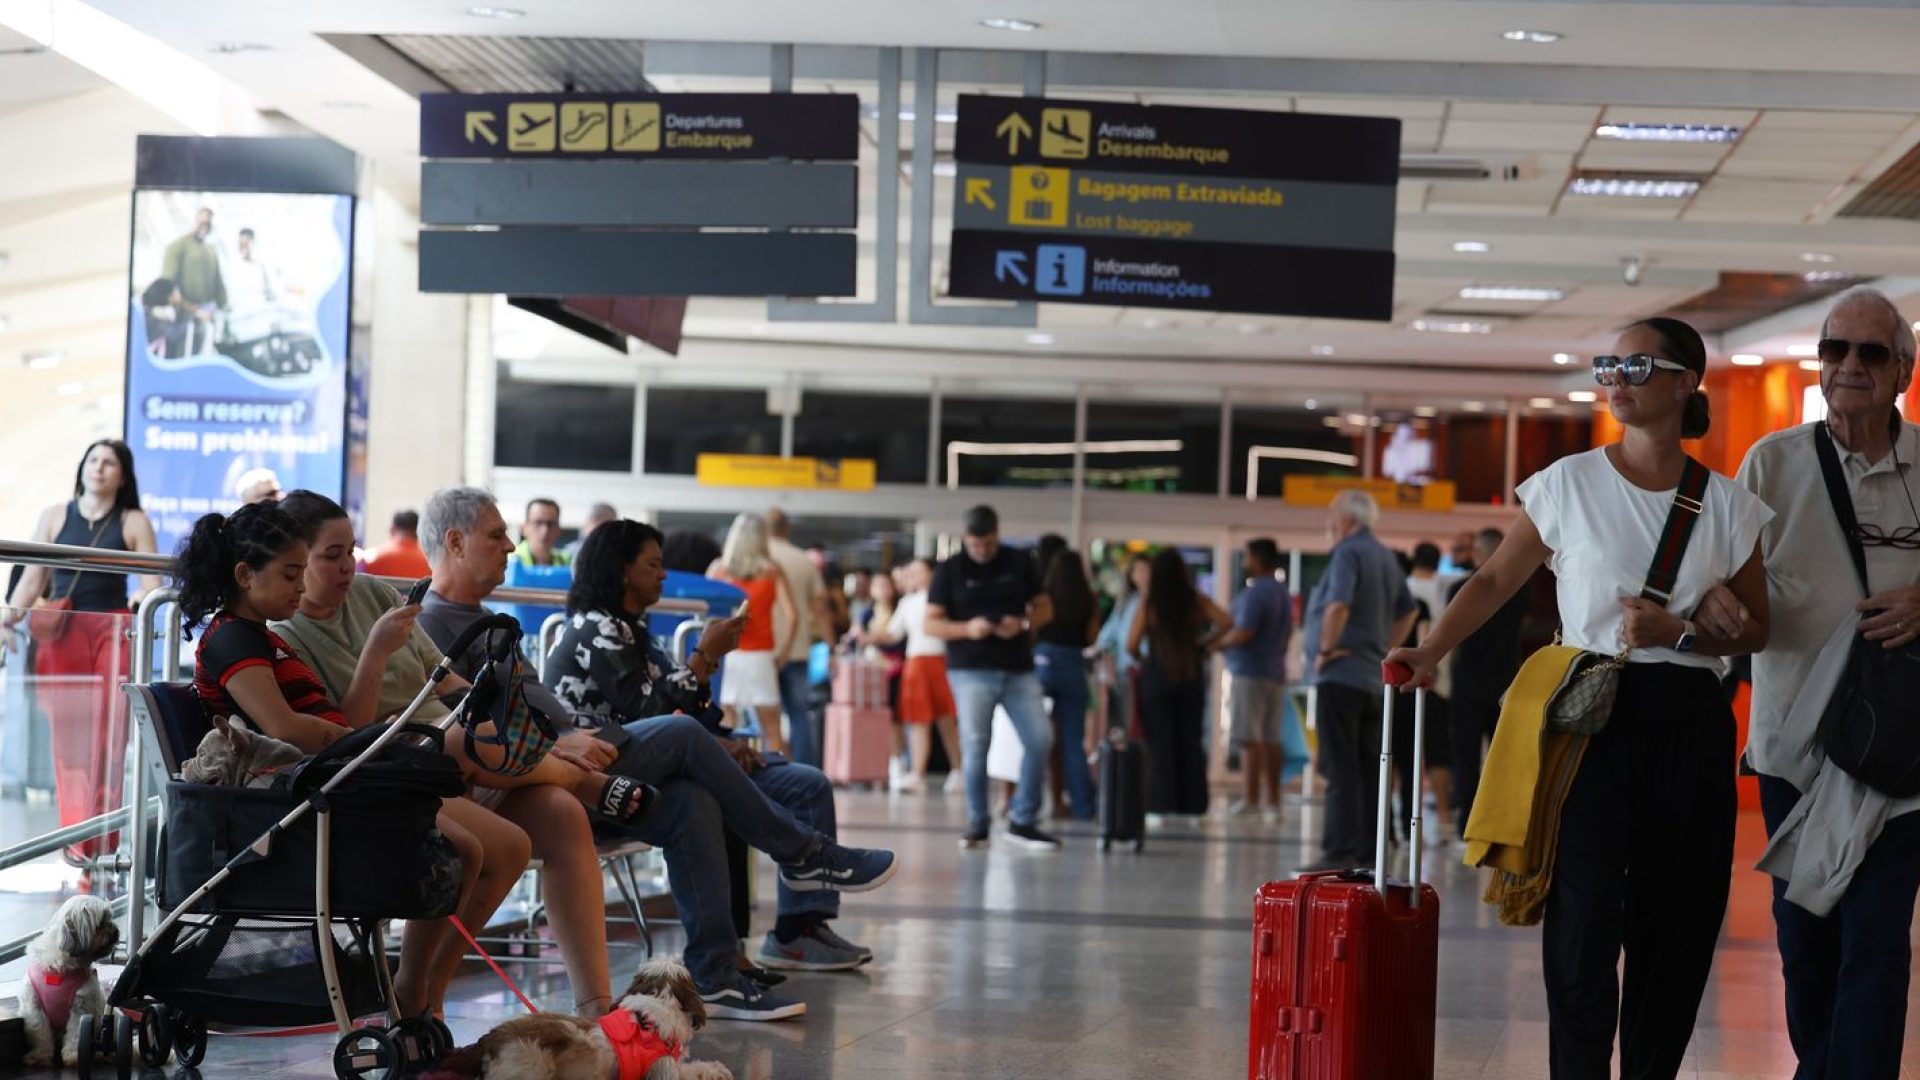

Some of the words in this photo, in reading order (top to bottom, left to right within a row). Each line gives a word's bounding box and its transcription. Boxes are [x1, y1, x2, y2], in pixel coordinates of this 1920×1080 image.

[665, 113, 743, 130] Departures
[1098, 122, 1155, 139] Arrivals
[665, 132, 753, 150] Embarque
[1097, 140, 1229, 164] Desembarque
[1078, 178, 1171, 201] Bagagem
[1177, 183, 1284, 206] Extraviada
[1075, 213, 1112, 230] Lost
[1116, 215, 1194, 236] baggage
[1093, 259, 1180, 278] Information
[1092, 277, 1211, 299] Informações
[146, 397, 198, 422] Sem
[203, 401, 306, 424] reserva?
[145, 427, 198, 450] Sem
[202, 428, 329, 456] problema!
[603, 777, 631, 815] VANS
